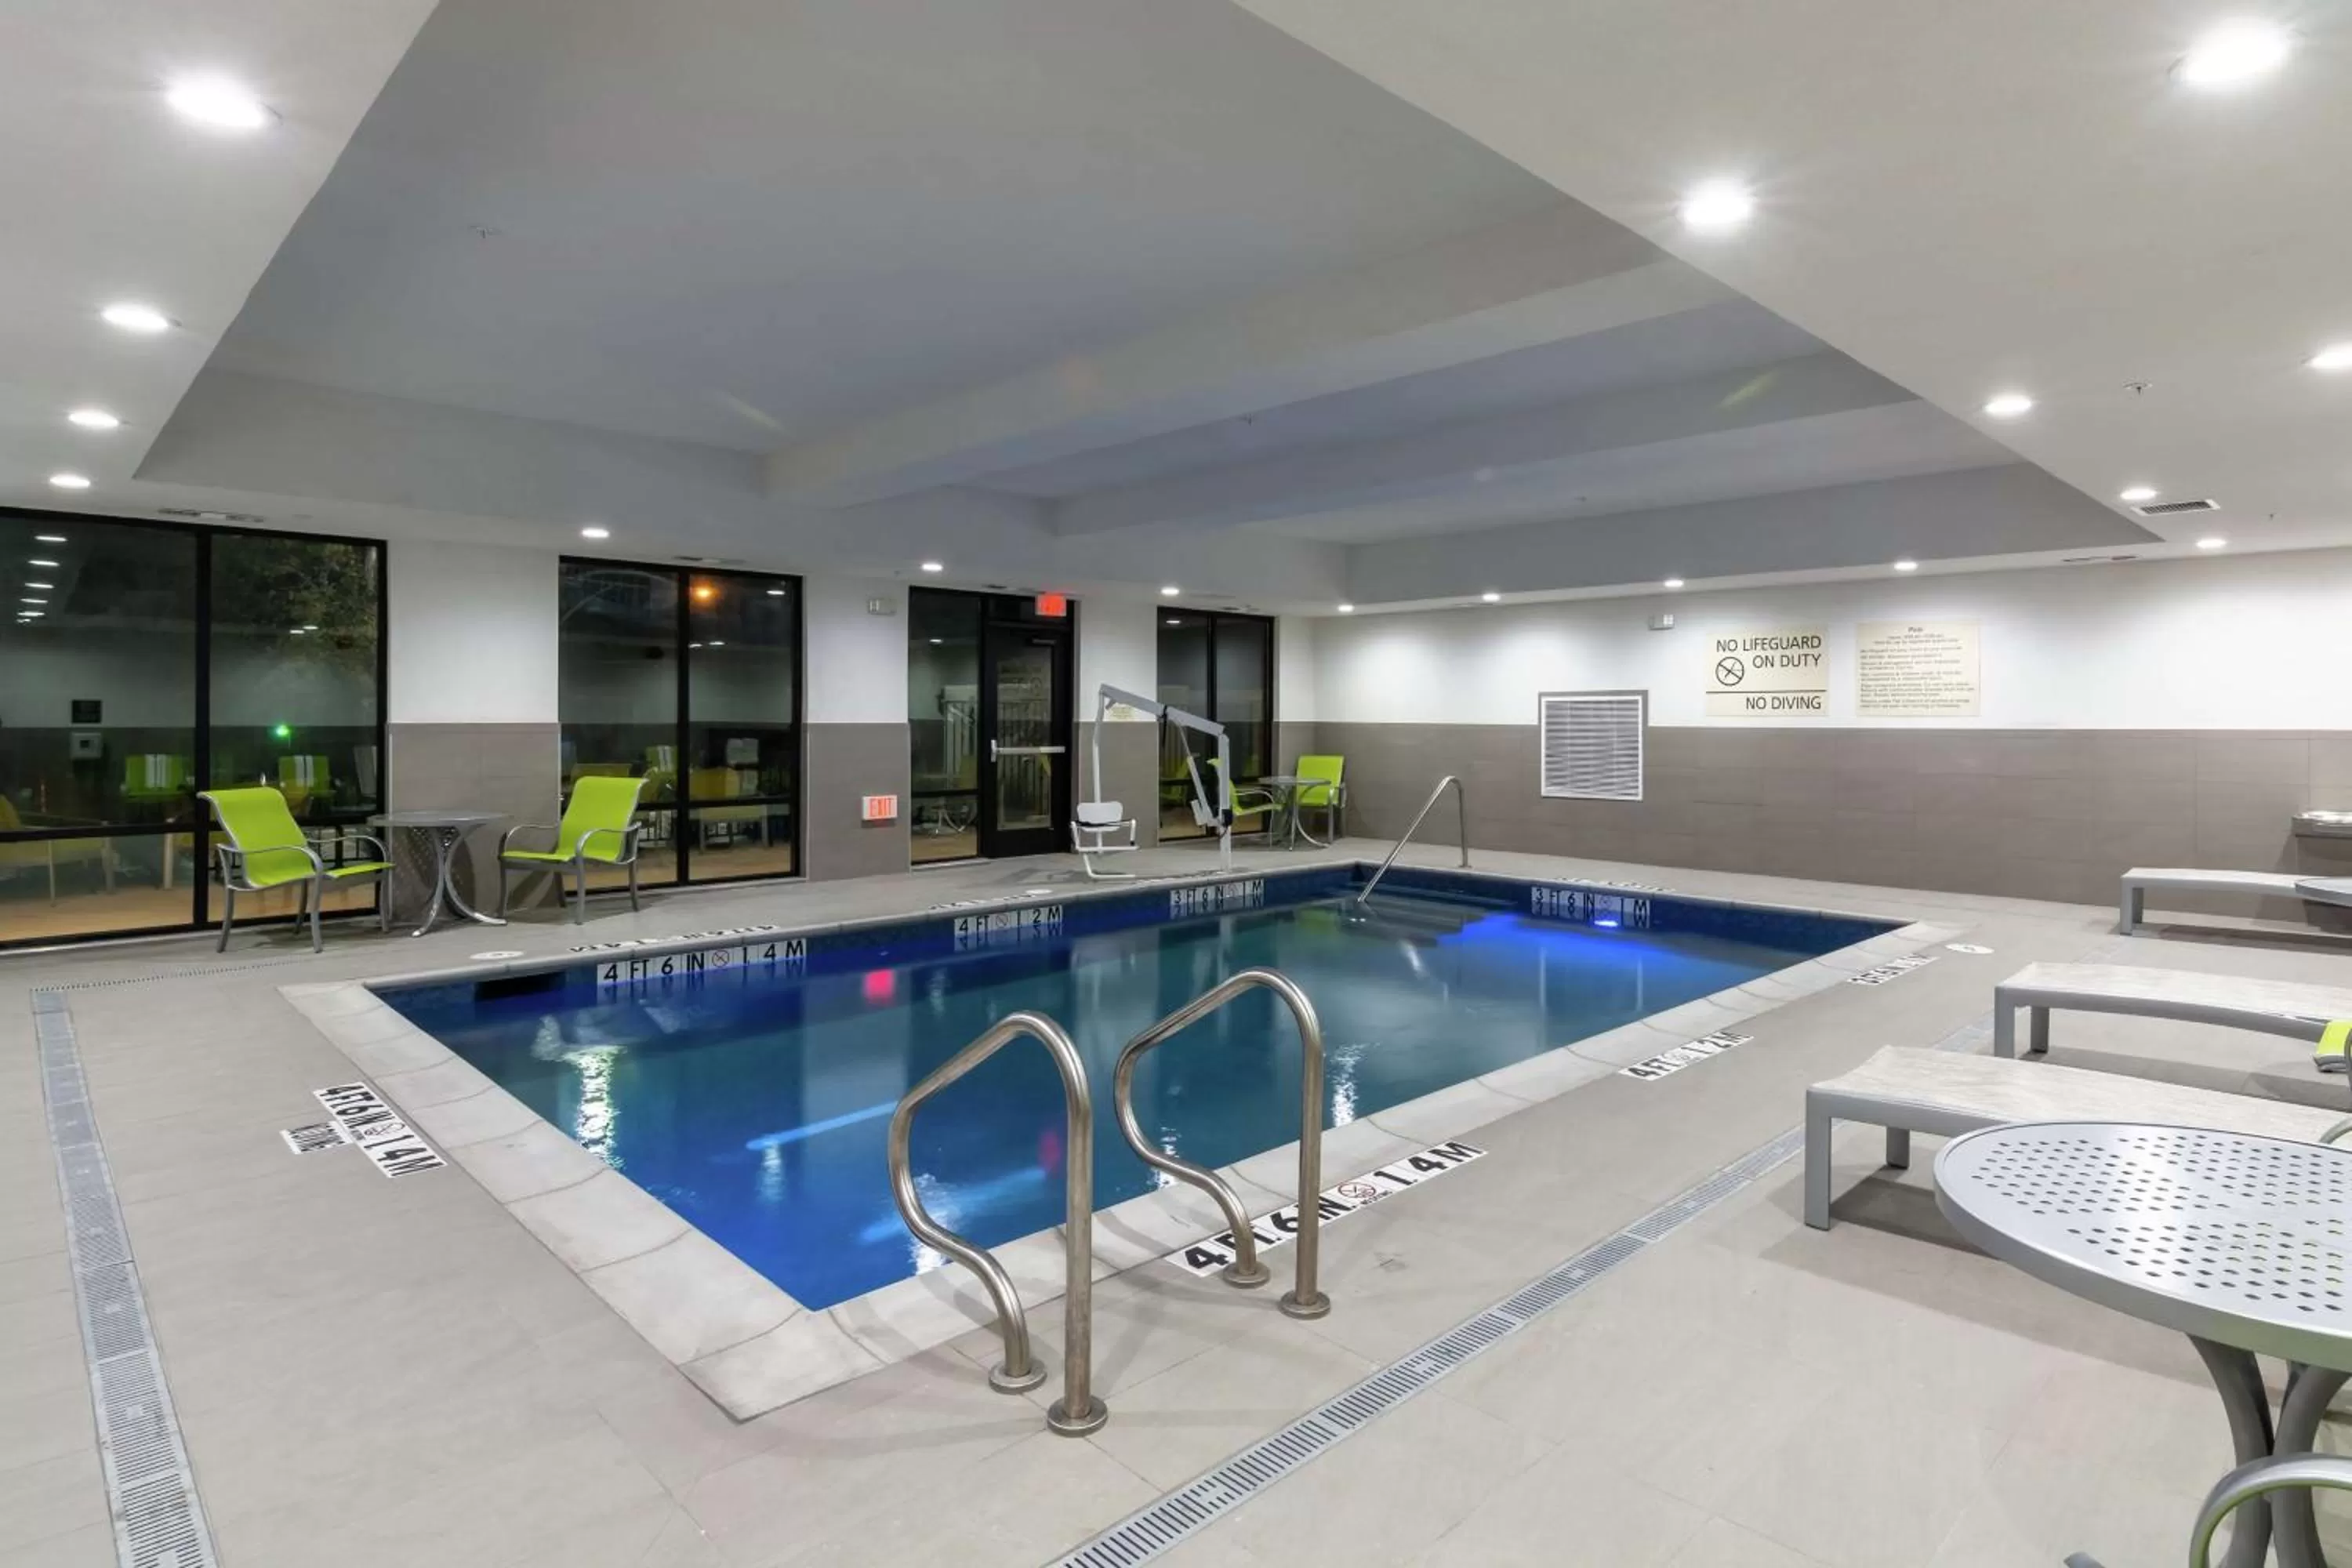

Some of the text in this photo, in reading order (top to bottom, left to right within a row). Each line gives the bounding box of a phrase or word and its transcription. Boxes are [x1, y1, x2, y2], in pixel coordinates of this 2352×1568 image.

[1716, 635, 1821, 652] NO LIFEGUARD
[1752, 653, 1821, 669] ON DUTY
[1746, 695, 1822, 710] NO DIVING
[869, 797, 894, 816] EXIT
[1536, 887, 1544, 902] 3
[1567, 892, 1575, 905] 6
[959, 917, 969, 933] 4
[976, 914, 989, 932] FT
[1047, 905, 1062, 924] M
[603, 963, 619, 982] 4
[630, 959, 650, 980] FT
[661, 956, 674, 975] 6
[687, 953, 705, 971] IN
[786, 939, 804, 958] M
[319, 1086, 365, 1097] 4
[336, 1105, 385, 1116] 6
[383, 1155, 445, 1177] M
[1185, 1246, 1230, 1269] 4
[1428, 1142, 1483, 1163] M
